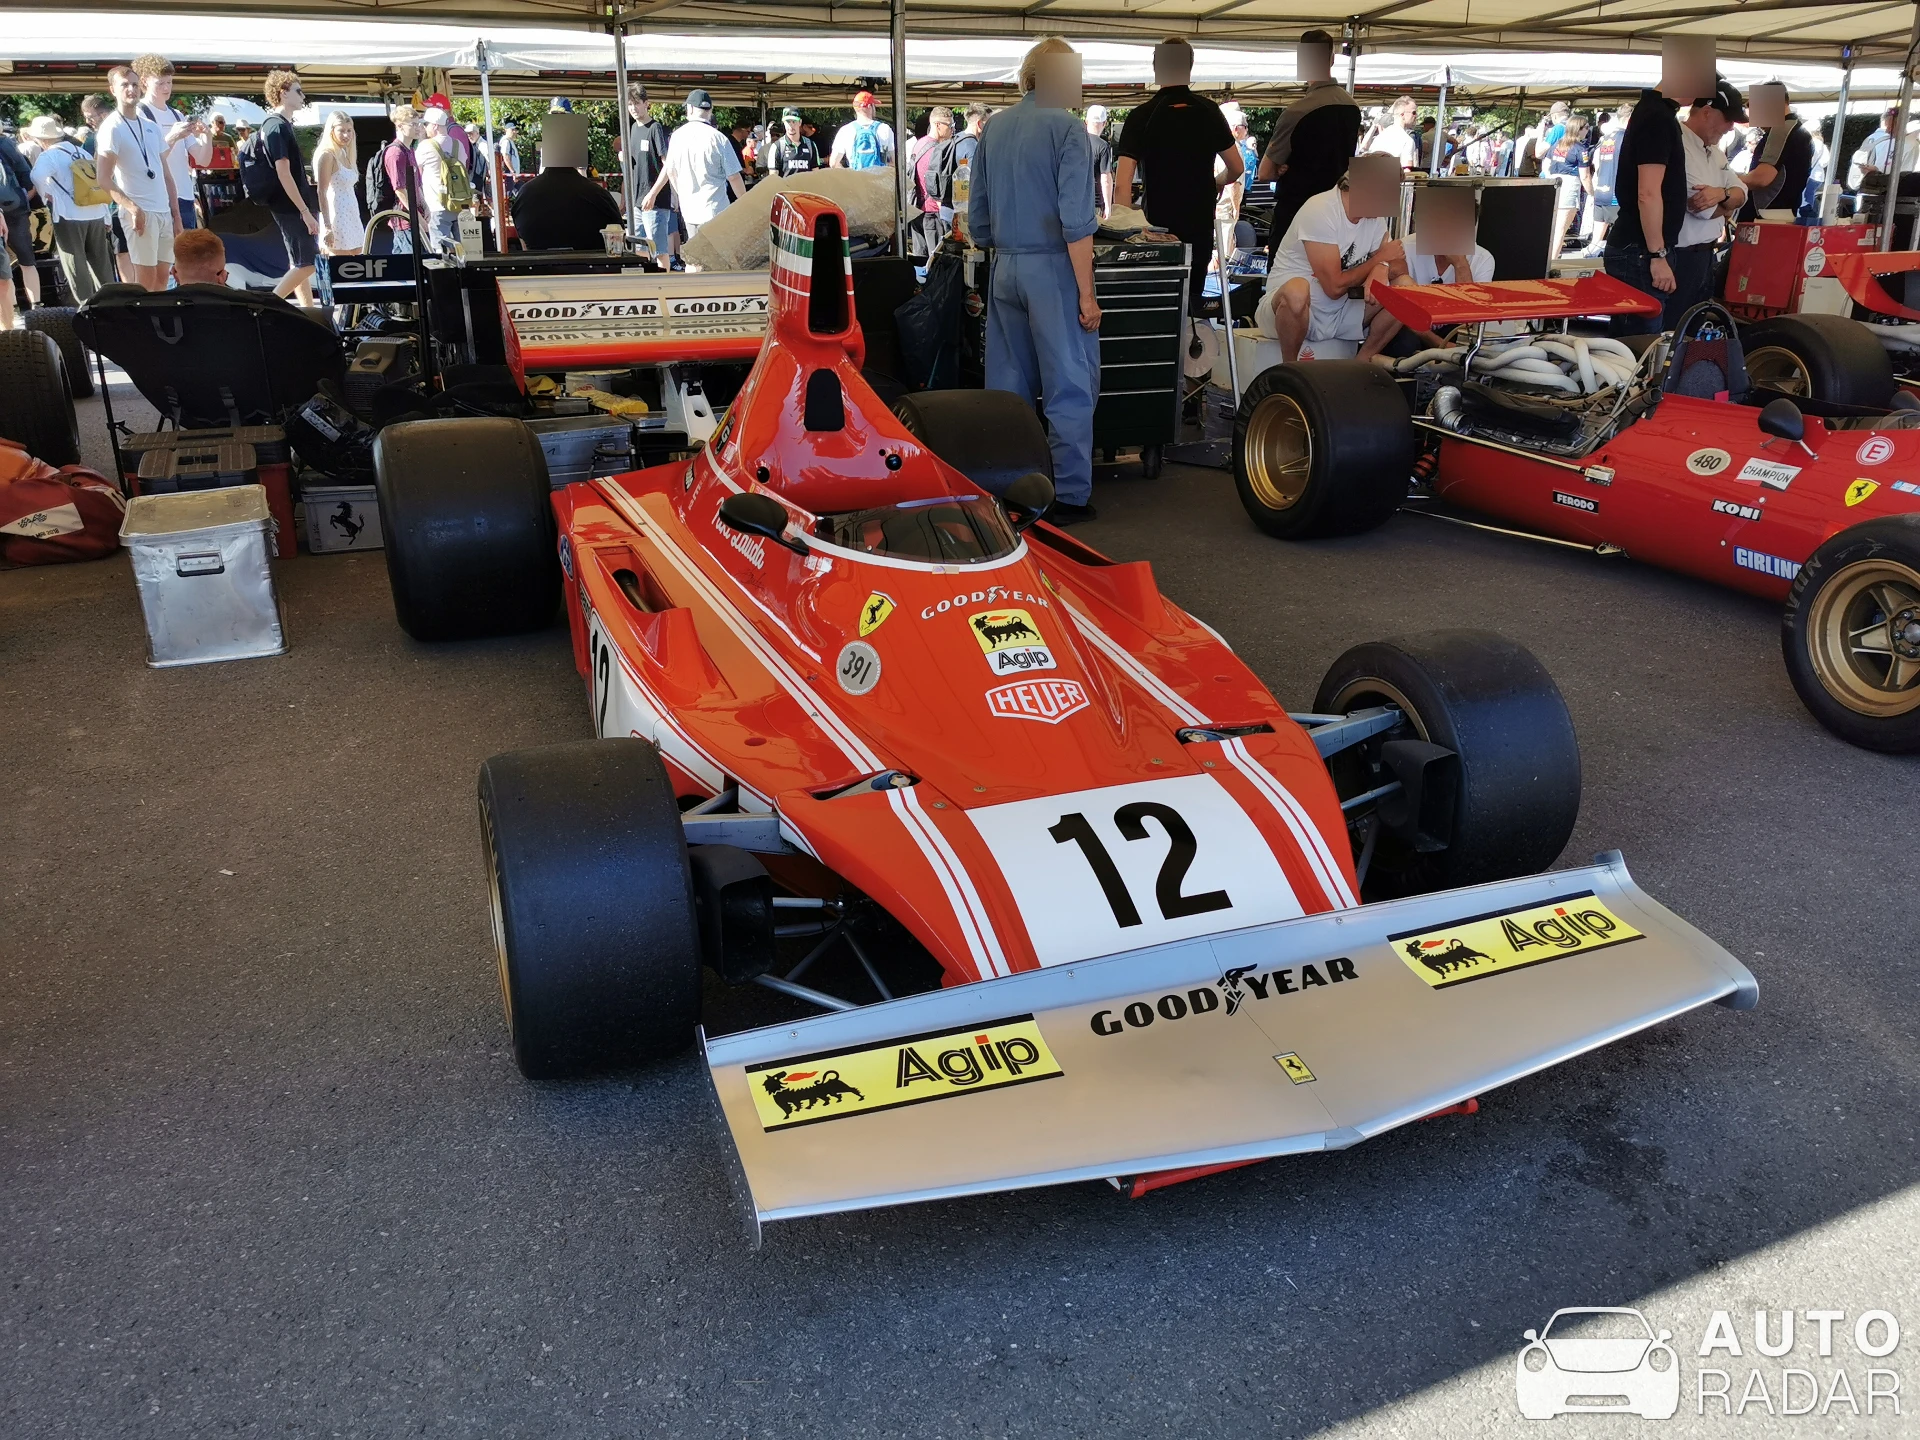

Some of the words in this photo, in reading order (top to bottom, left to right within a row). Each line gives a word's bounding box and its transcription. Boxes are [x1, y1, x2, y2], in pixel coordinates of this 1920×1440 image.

[788, 160, 808, 169] KICK
[1117, 250, 1159, 261] Snap-on
[338, 259, 388, 279] elf
[1865, 443, 1886, 460] E
[1693, 454, 1722, 470] 480
[1743, 465, 1792, 483] CHAMPION
[1556, 493, 1594, 511] FERODO
[1712, 500, 1761, 520] KONI
[842, 651, 873, 685] 391
[999, 649, 1049, 669] Agip
[996, 682, 1083, 717] HEUER
[1047, 801, 1234, 929] 12
[1499, 907, 1617, 952] Agip
[895, 1034, 1041, 1089] Agip
